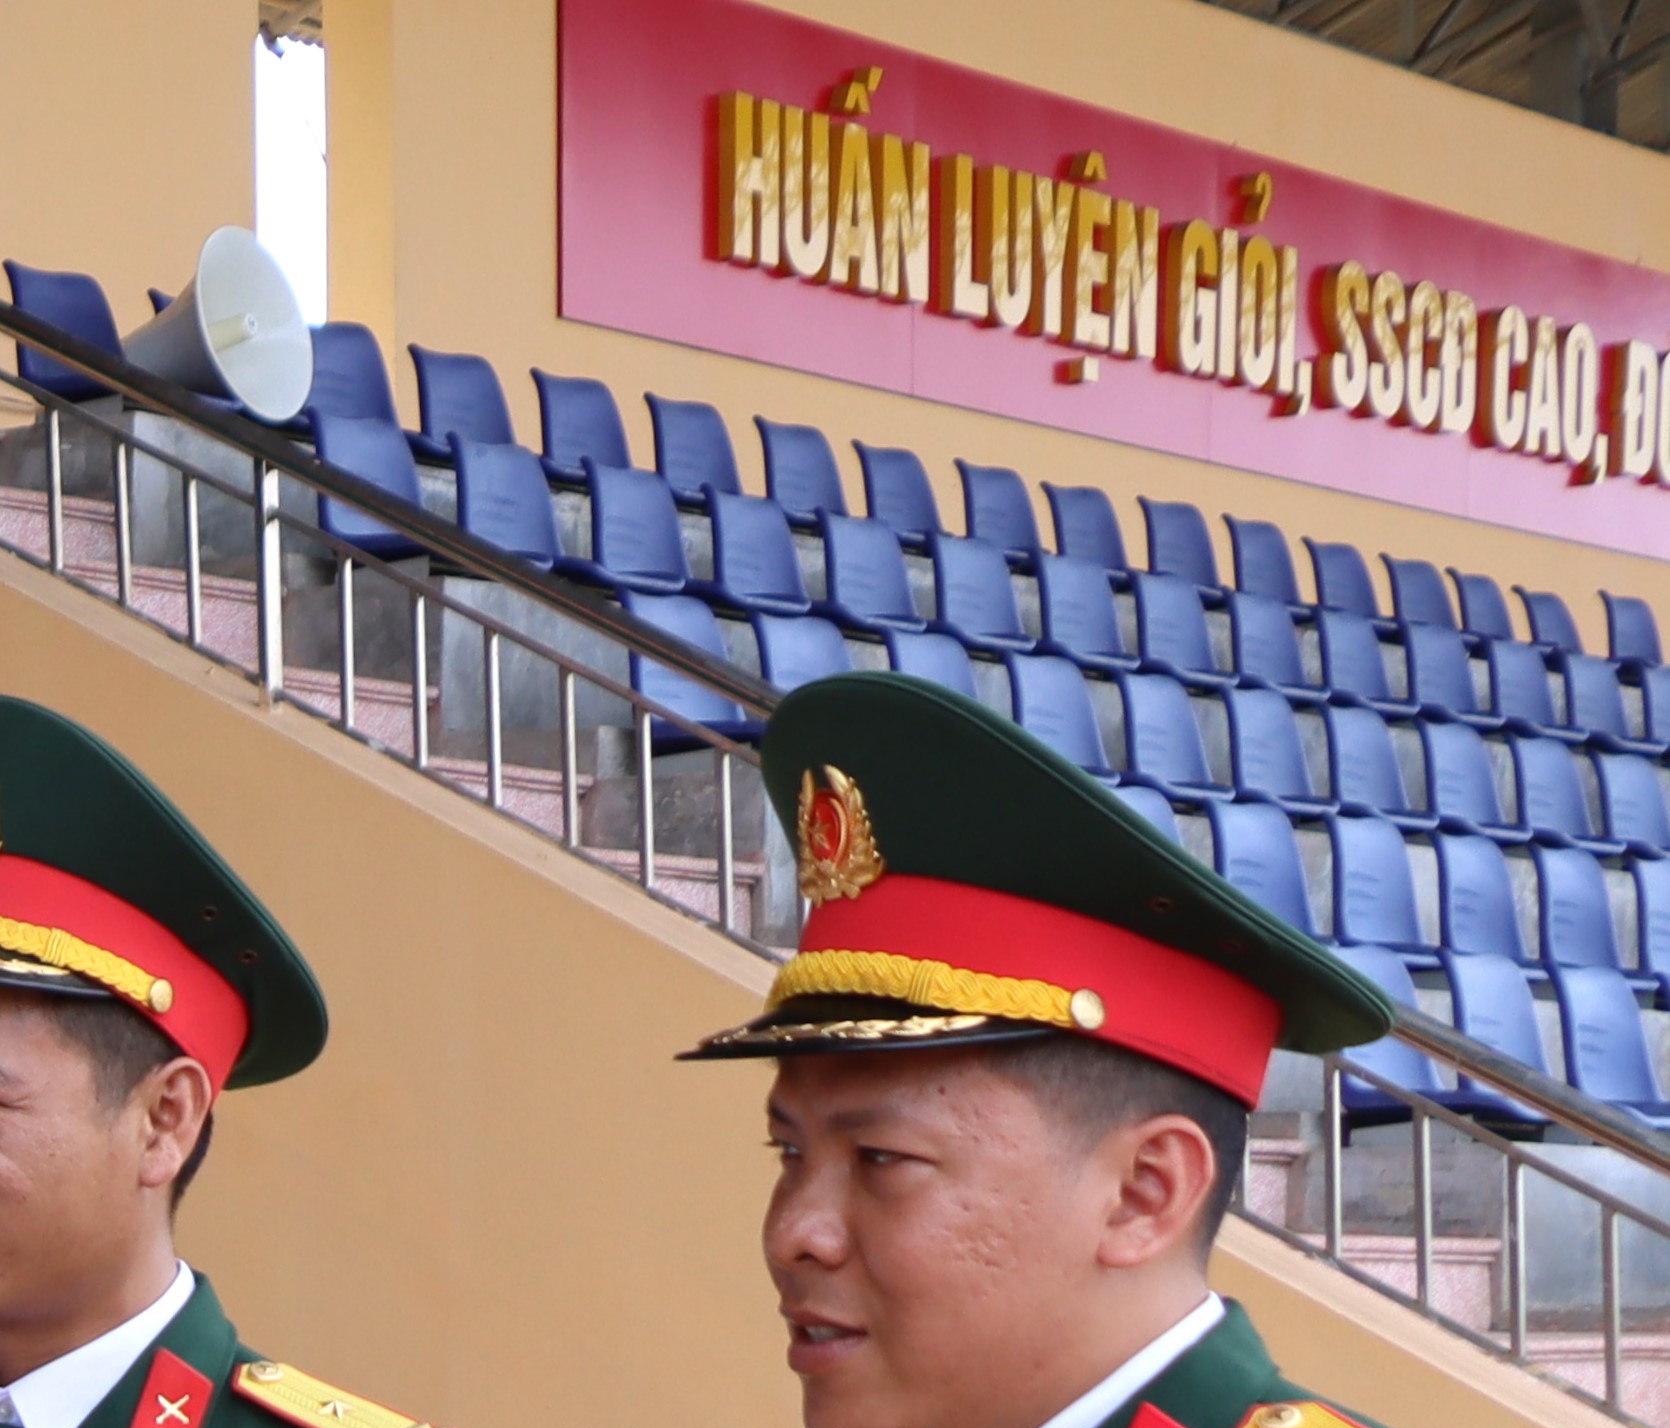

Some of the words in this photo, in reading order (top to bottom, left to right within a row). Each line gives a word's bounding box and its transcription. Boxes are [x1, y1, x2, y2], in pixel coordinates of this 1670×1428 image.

[724, 66, 930, 301] HUẤN
[947, 150, 1159, 382] LUYỆN
[1172, 172, 1312, 418] GIỎI,
[1327, 259, 1478, 434] SSCĐ
[1490, 305, 1608, 484] CAO,
